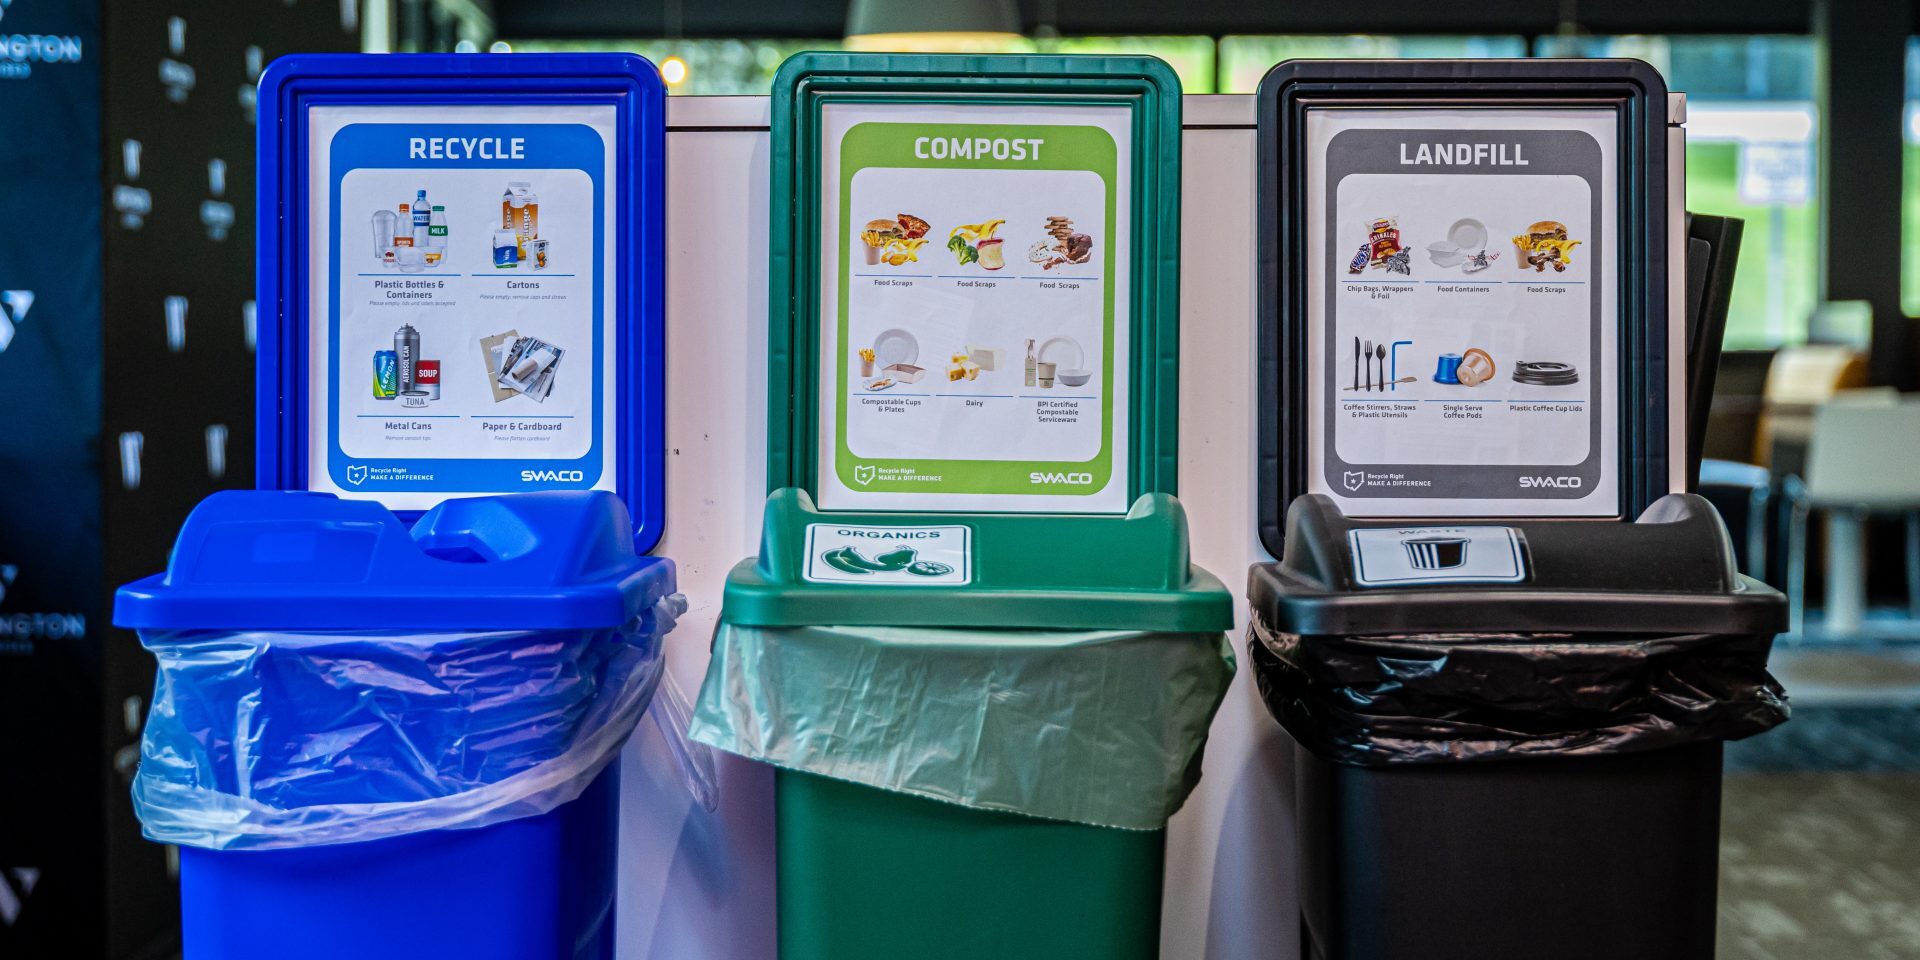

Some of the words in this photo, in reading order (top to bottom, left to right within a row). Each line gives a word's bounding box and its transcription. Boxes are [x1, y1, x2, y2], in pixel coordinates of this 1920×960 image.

[409, 137, 525, 160] RECYCLE
[914, 136, 1044, 161] COMPOST
[1400, 143, 1529, 166] LANDFILL
[374, 280, 403, 289] Plastic
[405, 280, 436, 289] Bottles
[438, 280, 445, 289] &
[506, 281, 540, 289] Cartons
[1347, 285, 1361, 293] Chip
[1363, 285, 1381, 293] Bags,
[1382, 285, 1414, 293] Wrappers
[1437, 285, 1454, 293] Food
[1545, 286, 1566, 294] Scraps
[386, 291, 433, 299] Containers
[381, 360, 395, 389] LEMON
[418, 369, 438, 378] SOUP
[406, 397, 425, 406] TUNA
[862, 398, 904, 406] Compostable
[966, 399, 984, 407] Dairy
[1036, 408, 1079, 416] Compostable
[1443, 404, 1463, 412] Single
[1555, 405, 1567, 413] Cup
[385, 422, 409, 430] Metal
[411, 422, 432, 430] Cans
[482, 422, 507, 432] Paper
[509, 422, 516, 430] &
[518, 422, 562, 430] Cardboard
[521, 470, 583, 482] SWACO
[1030, 472, 1092, 485] SWACO
[1519, 476, 1582, 488] SWACO
[837, 529, 941, 539] ORGANICS
